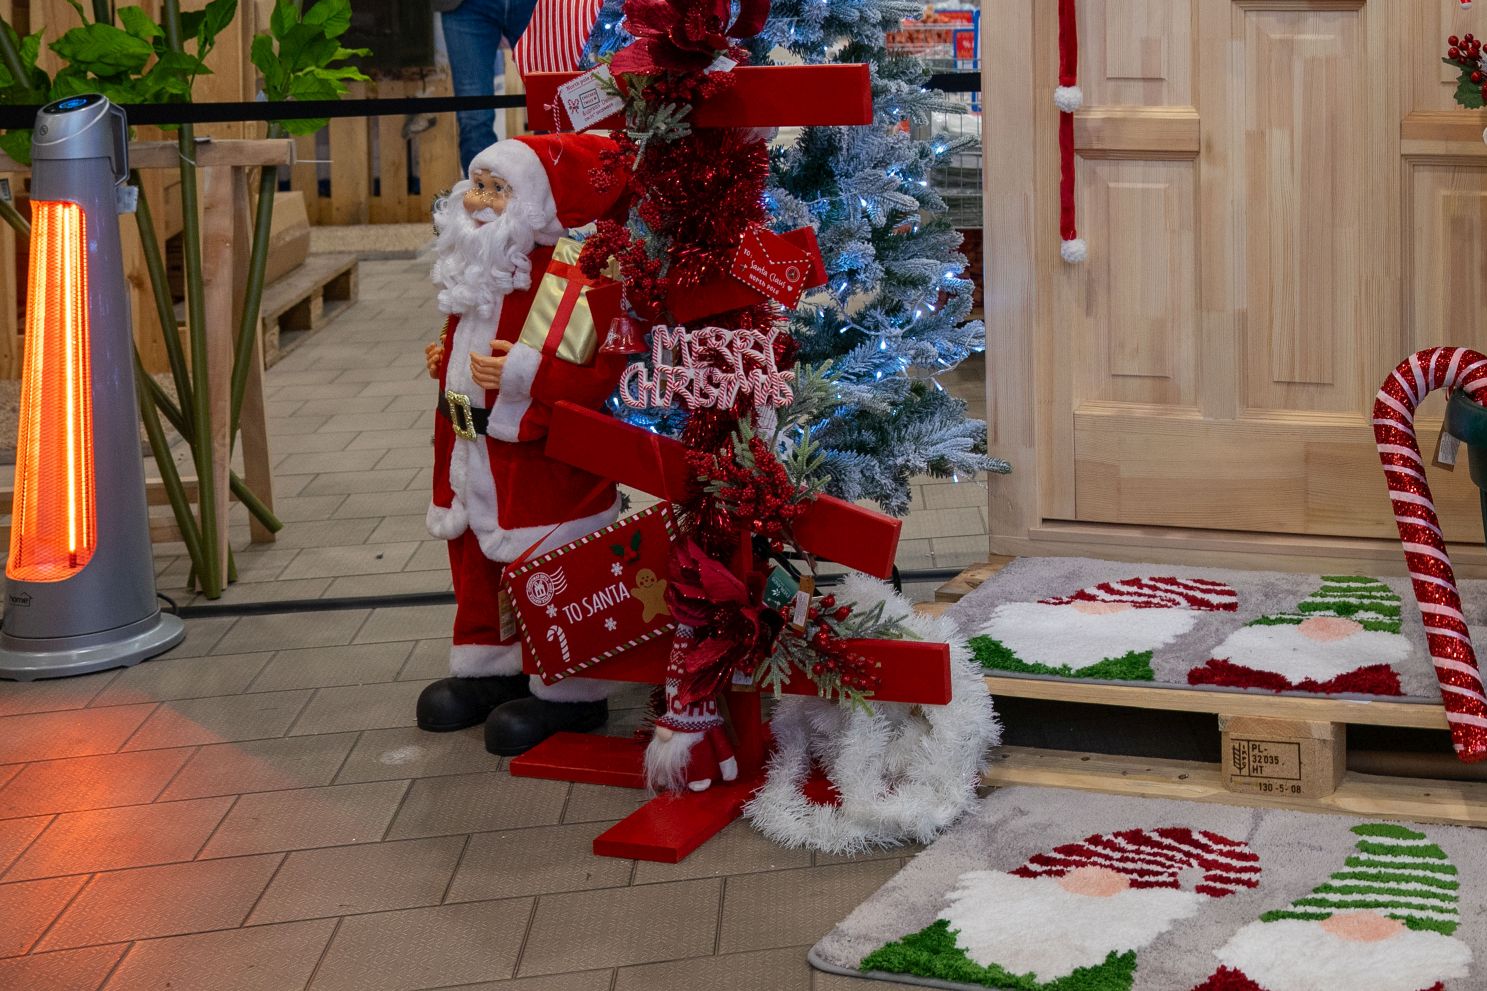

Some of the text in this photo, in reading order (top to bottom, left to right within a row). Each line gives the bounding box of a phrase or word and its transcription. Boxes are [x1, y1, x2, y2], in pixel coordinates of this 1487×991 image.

[750, 260, 787, 289] Santa Claus
[766, 284, 780, 295] POLE
[651, 324, 780, 372] MERRY
[619, 361, 796, 410] CHRISTMAS
[562, 602, 583, 625] TO
[583, 581, 631, 617] SANTA
[1251, 743, 1268, 753] PL-
[1252, 765, 1264, 775] HT
